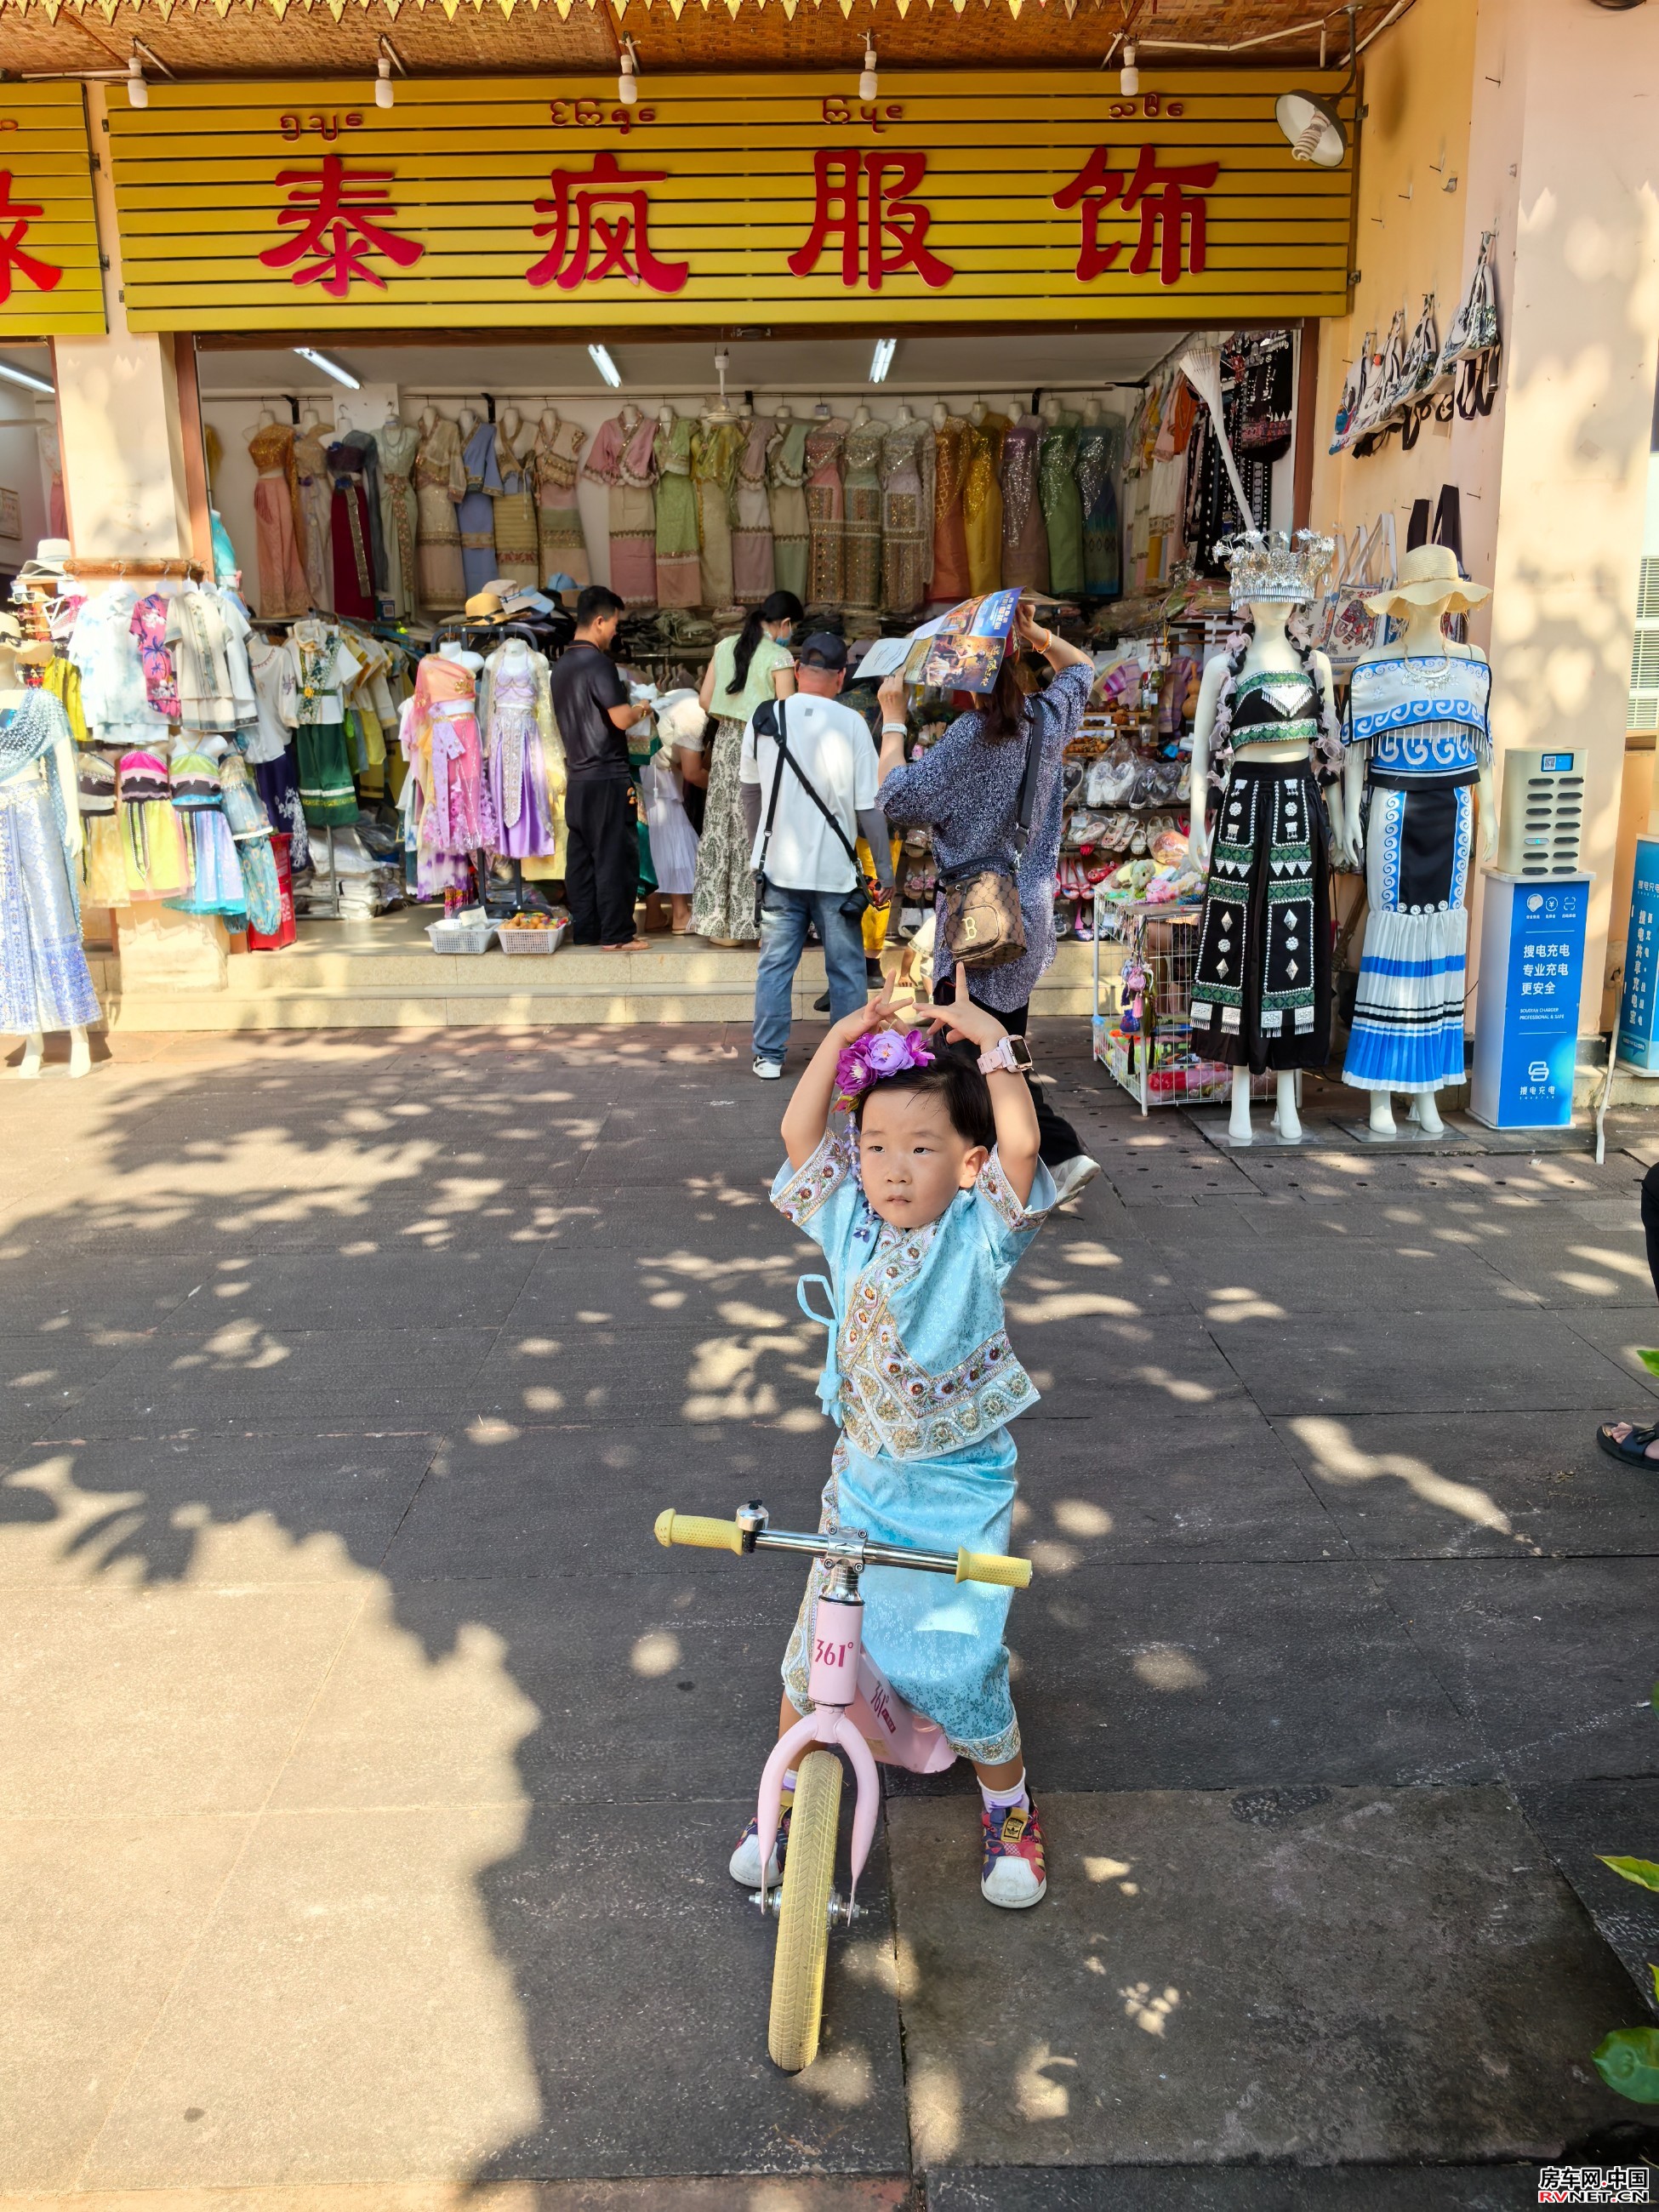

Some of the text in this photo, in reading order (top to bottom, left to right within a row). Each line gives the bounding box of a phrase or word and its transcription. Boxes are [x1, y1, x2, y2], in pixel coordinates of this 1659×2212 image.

[259, 143, 1219, 298] 泰疯服饰
[961, 916, 978, 941] B
[1523, 943, 1571, 959] 搜电充电
[1522, 962, 1569, 978] 专业充电
[1520, 981, 1556, 996] 更安全
